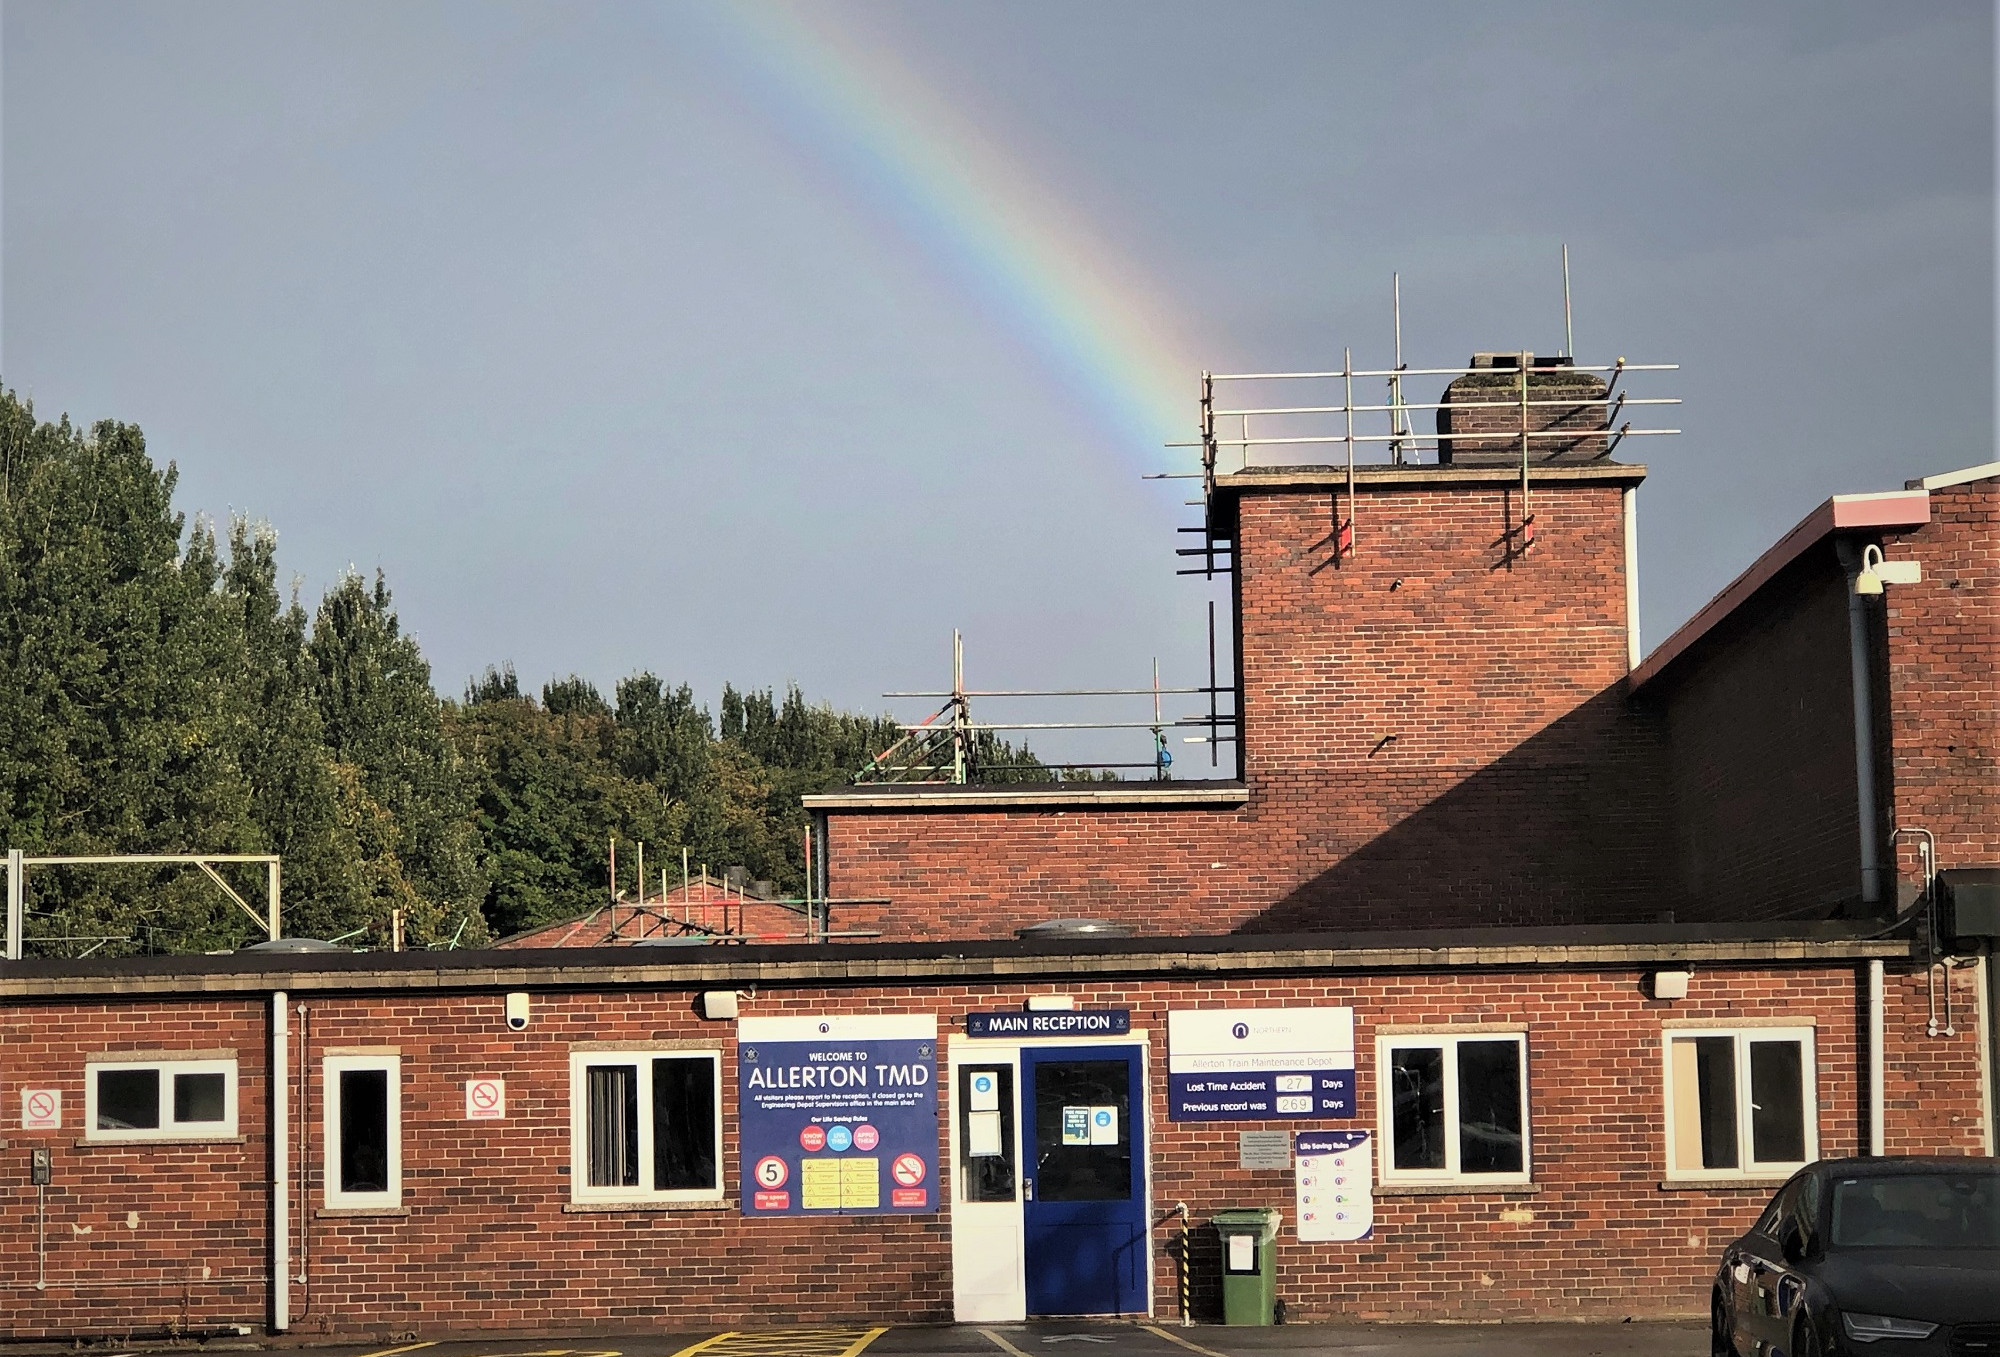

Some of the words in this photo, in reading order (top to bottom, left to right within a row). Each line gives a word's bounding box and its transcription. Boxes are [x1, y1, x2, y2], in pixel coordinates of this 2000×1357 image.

[989, 1018, 1028, 1031] MAIN
[1032, 1016, 1110, 1031] RECEPTION
[809, 1053, 852, 1062] WELCOME
[855, 1052, 868, 1061] TO
[1193, 1060, 1224, 1068] Allerton
[1228, 1059, 1249, 1067] Train
[1252, 1058, 1305, 1066] Maintenance
[1308, 1058, 1332, 1066] Depot
[748, 1066, 867, 1089] ALLERTON
[875, 1065, 929, 1087] TMD
[1187, 1083, 1205, 1091] Lost
[1207, 1083, 1228, 1091] Time
[1230, 1082, 1266, 1090] Accident
[1287, 1078, 1302, 1089] 27
[1322, 1080, 1343, 1089] Days
[815, 1101, 848, 1109] Supervisors
[1183, 1103, 1219, 1112] Previous
[1221, 1102, 1247, 1111] record
[1282, 1099, 1307, 1110] 269
[1323, 1100, 1343, 1109] Days
[765, 1164, 777, 1182] 5
